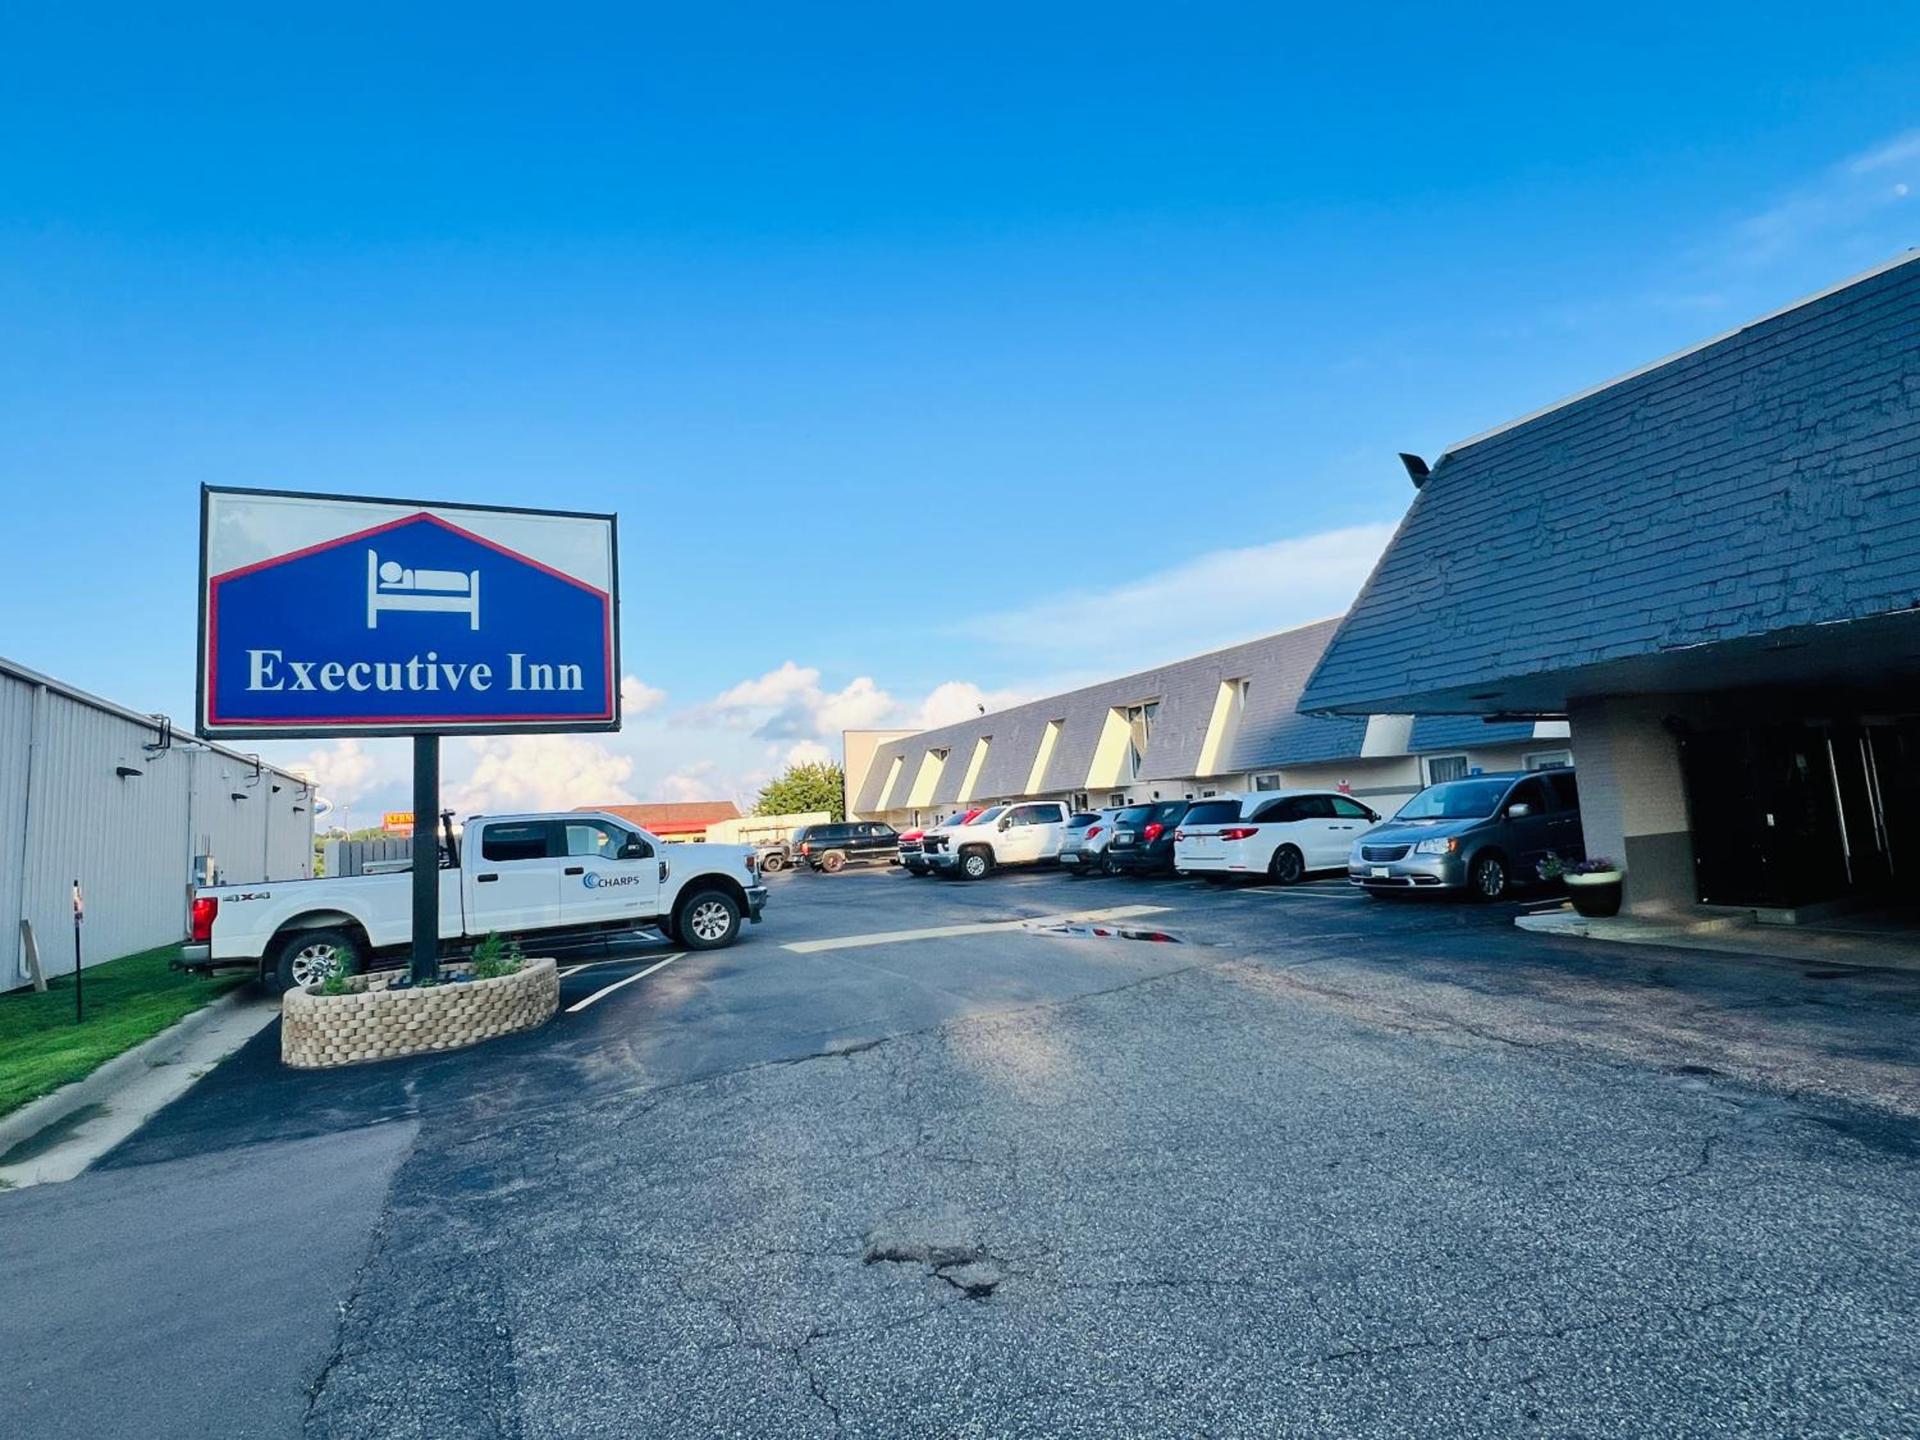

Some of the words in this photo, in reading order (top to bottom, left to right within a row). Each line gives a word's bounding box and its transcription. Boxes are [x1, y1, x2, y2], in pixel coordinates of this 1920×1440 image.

[245, 649, 492, 692] Executive
[506, 652, 584, 691] Inn
[598, 876, 640, 888] CHARPS
